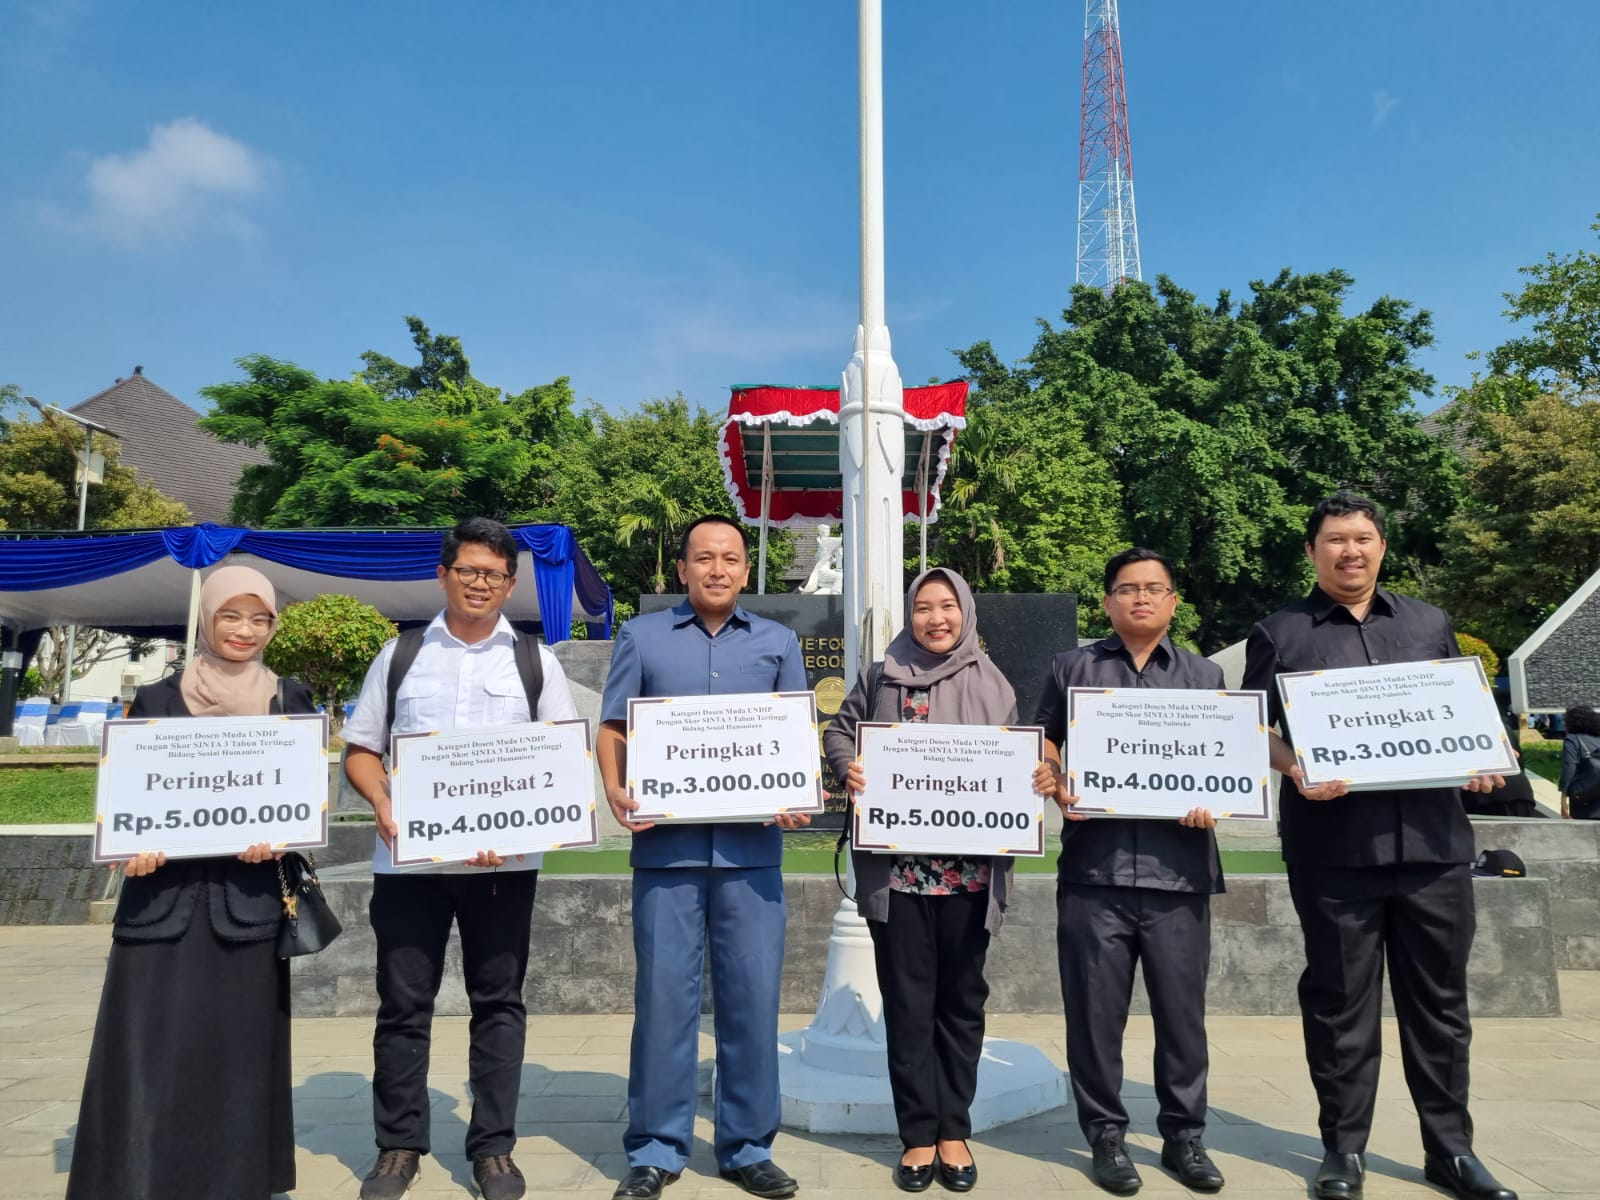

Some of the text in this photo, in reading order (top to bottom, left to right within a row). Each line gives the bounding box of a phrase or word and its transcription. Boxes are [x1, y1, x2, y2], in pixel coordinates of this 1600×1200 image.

[1328, 705, 1454, 729] Peringkat 3
[136, 743, 168, 751] Dengan
[260, 739, 295, 747] Tertinggi
[530, 743, 562, 751] Tertinggi
[666, 740, 780, 761] Peringkat 3
[1106, 738, 1225, 760] Peringkat 2
[1312, 734, 1493, 765] Rp.3.000.000
[146, 768, 282, 792] Peringkat 1
[432, 772, 553, 799] Peringkat 2
[642, 772, 806, 799] Rp.3.000.000
[891, 774, 1004, 795] Peringkat 1
[1084, 771, 1253, 793] Rp.4.000.000
[113, 803, 310, 835] Rp.5.000.000
[408, 805, 581, 841] Rp.4.000.000
[869, 808, 1029, 829] Rp.5.000.000
